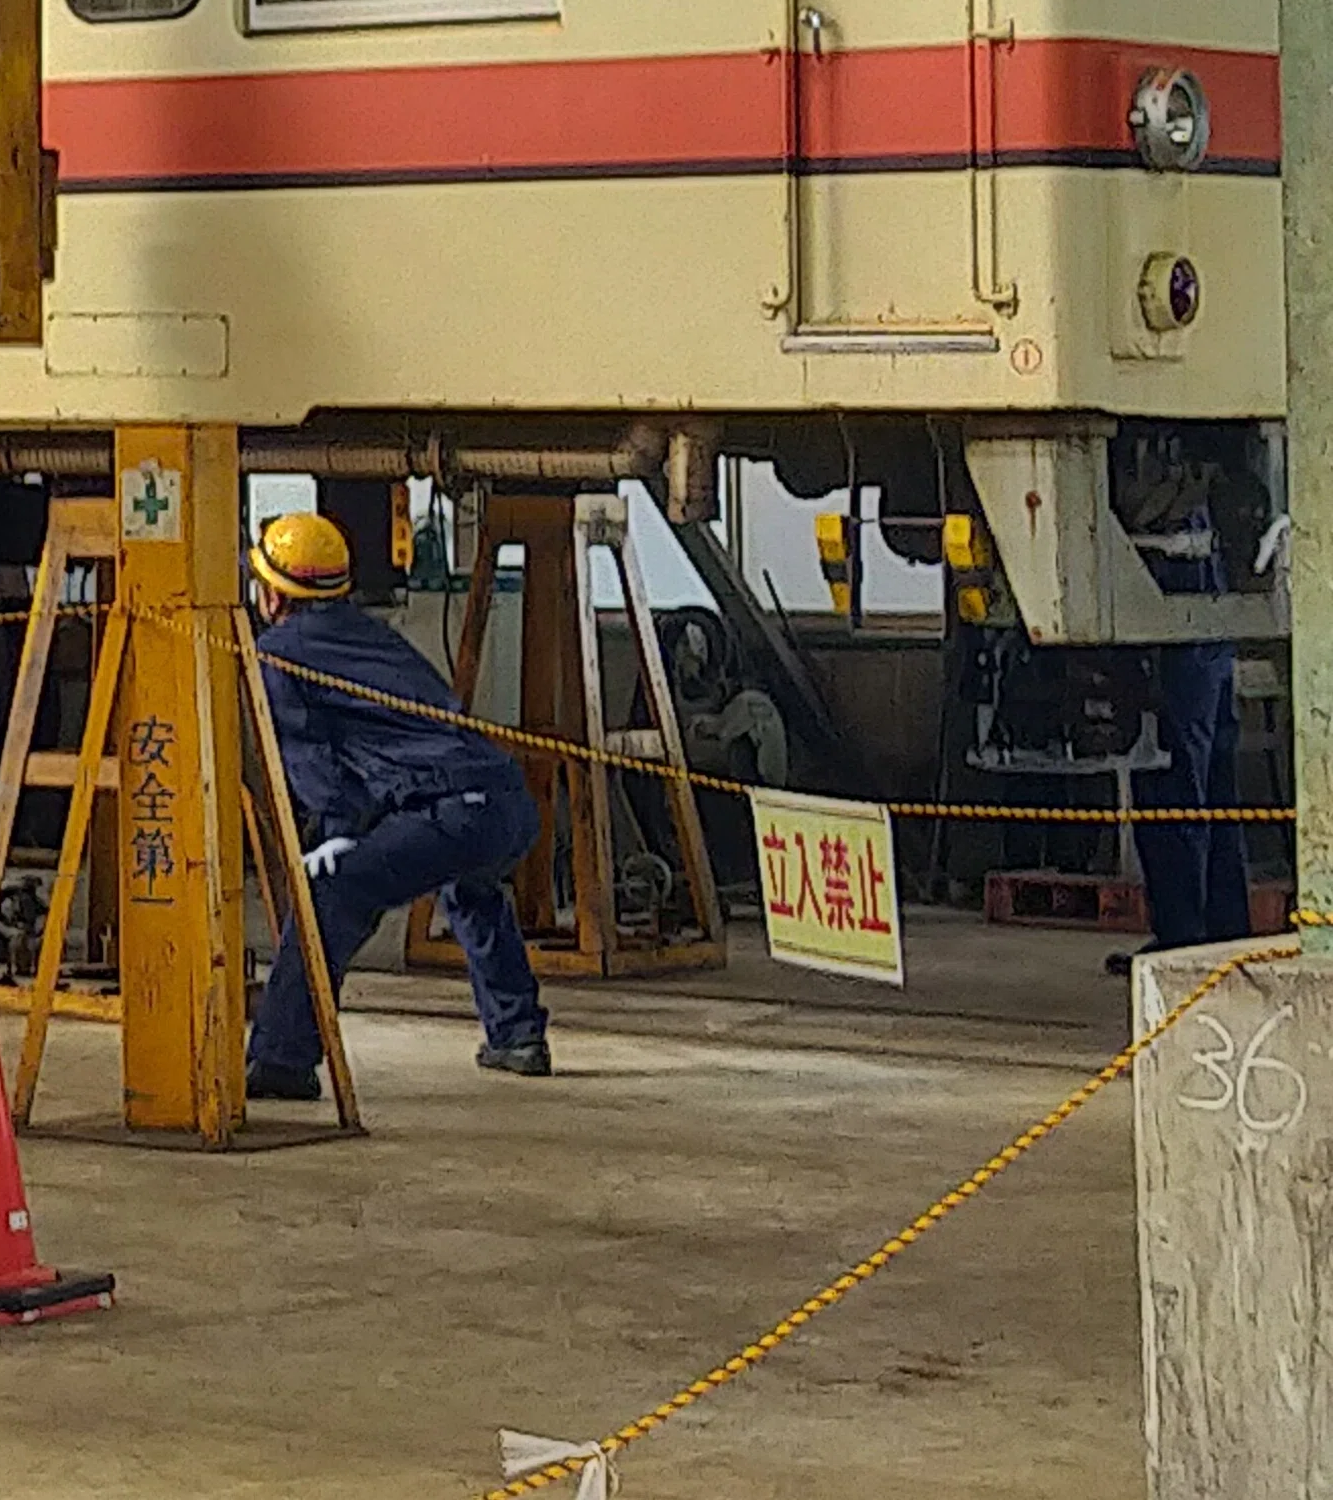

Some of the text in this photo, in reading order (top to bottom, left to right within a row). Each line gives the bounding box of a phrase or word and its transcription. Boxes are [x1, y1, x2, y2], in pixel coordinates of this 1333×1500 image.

[130, 713, 175, 904] 安全第一
[762, 822, 892, 935] 立入禁止
[1177, 1004, 1308, 1132] 36
